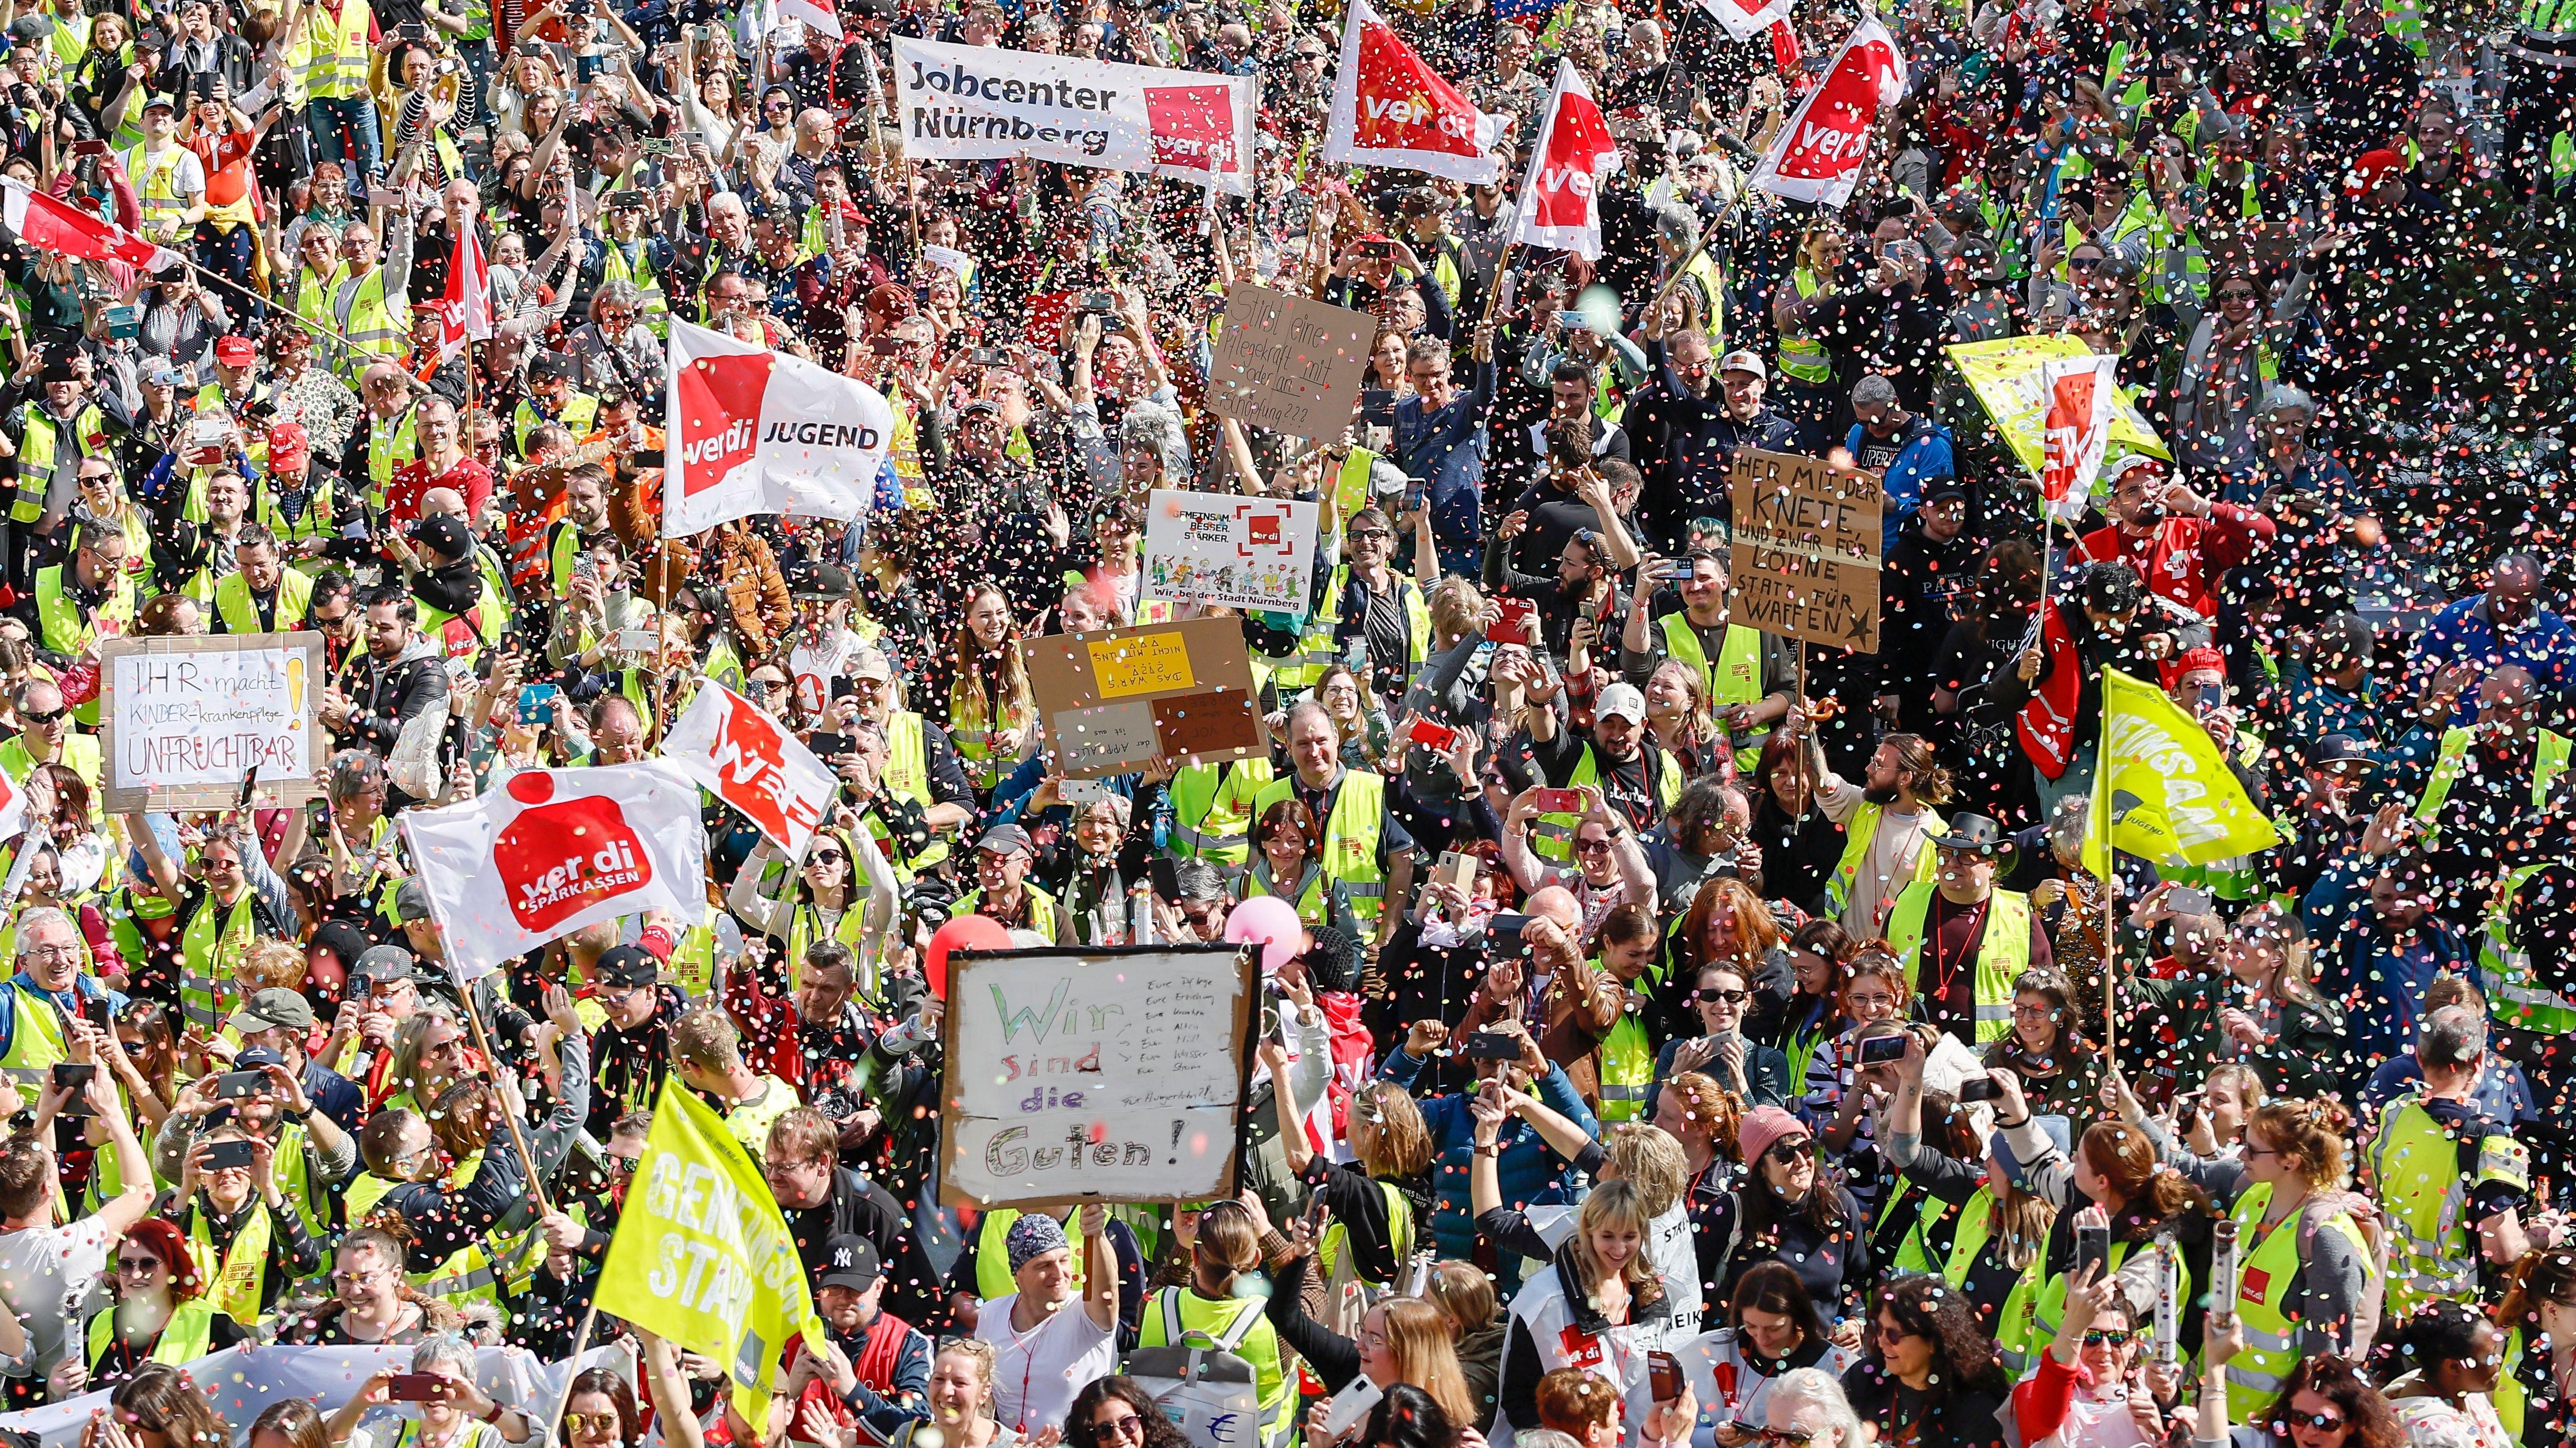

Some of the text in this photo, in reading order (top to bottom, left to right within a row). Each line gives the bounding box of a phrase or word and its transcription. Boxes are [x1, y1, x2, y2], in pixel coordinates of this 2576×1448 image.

[910, 61, 1117, 111] Jobcenter
[914, 107, 1109, 156] Nürnberg
[1545, 167, 1592, 198] ve
[1231, 290, 1324, 348] Stirbt eine
[1223, 325, 1332, 385] Pflegekraft mit
[1246, 365, 1293, 392] oder an
[764, 421, 879, 451] JUGEND
[1738, 457, 1878, 504] HER MIT DER
[1752, 485, 1861, 540] KNETE,
[1184, 530, 1229, 544] STÄRKER.
[1190, 522, 1230, 533] BESSER.
[1739, 524, 1869, 562] UND ZWAR FÜR
[1751, 544, 1839, 581] LÖHNE
[1738, 574, 1794, 597] STATT
[1198, 590, 1216, 601] der
[1217, 593, 1245, 603] Stadt
[1248, 597, 1299, 610] Nürnberg
[1812, 588, 1855, 614] FÜR
[1743, 596, 1840, 634] WAFFEN
[1095, 646, 1181, 662] NICHT MIT UNS
[137, 662, 202, 694] IHR
[215, 670, 282, 692] macht
[1108, 671, 1182, 689] DAS WAR'S
[130, 703, 284, 726] KINDER-krankenpflege
[1115, 727, 1126, 736] ist
[1136, 739, 1150, 748] der
[129, 733, 296, 776] UNFRUCHTBAR
[2127, 816, 2164, 836] JUGEND
[520, 840, 636, 900] ver.di
[527, 870, 640, 914] SPARKASSEN
[258, 908, 271, 927] KYLIE
[1147, 980, 1173, 990] Eure
[989, 978, 1124, 1045] Wir
[1146, 997, 1166, 1006] Eure
[1002, 1042, 1104, 1081] sind
[1020, 1086, 1085, 1113] die
[986, 1124, 1151, 1177] Guten
[1401, 1188, 1415, 1198] EYES
[834, 1247, 853, 1267] NY
[2242, 1285, 2263, 1301] ver.di
